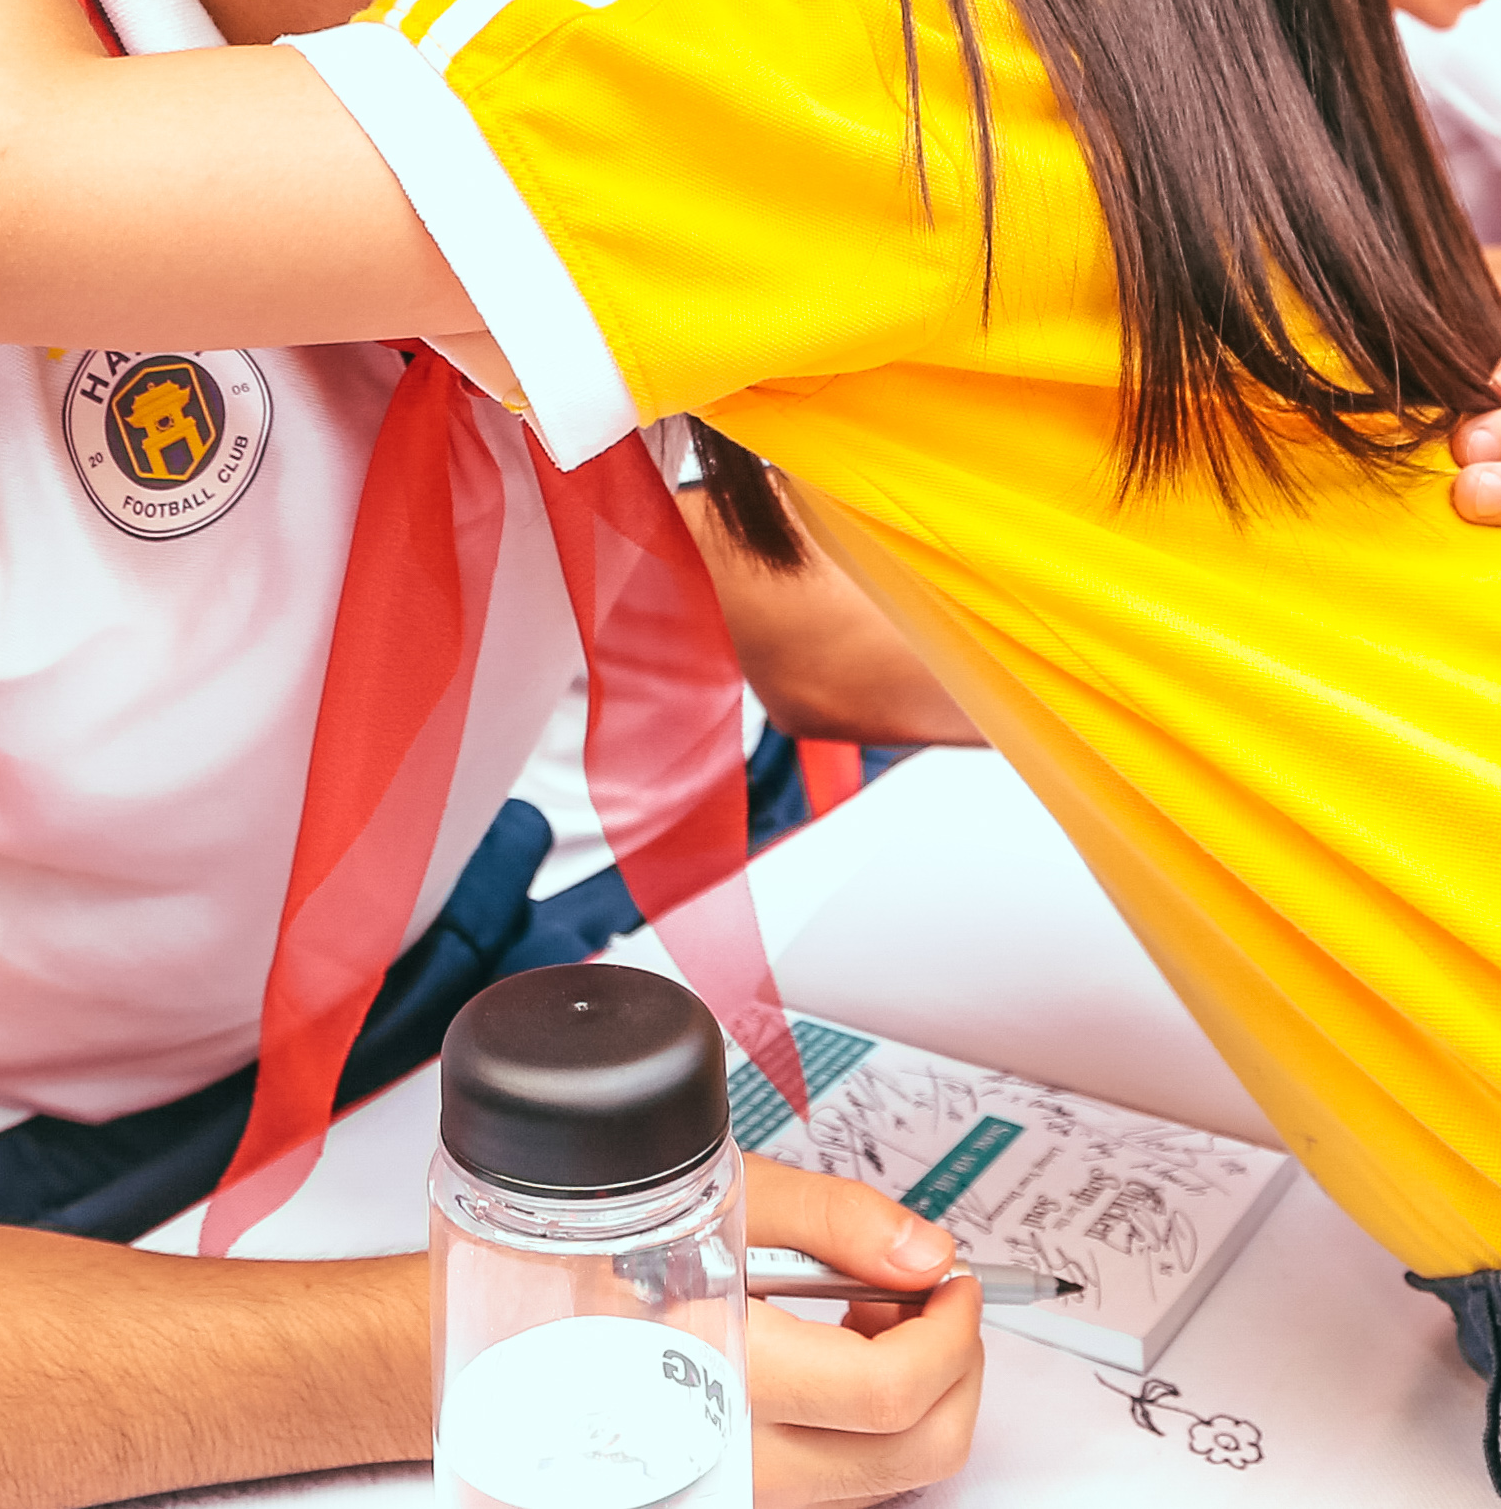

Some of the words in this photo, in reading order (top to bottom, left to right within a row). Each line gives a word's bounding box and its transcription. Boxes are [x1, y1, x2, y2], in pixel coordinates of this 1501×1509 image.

[231, 382, 251, 396] 06
[87, 451, 105, 469] 20
[122, 487, 216, 519] FOOTBALL
[217, 435, 249, 484] CLUB
